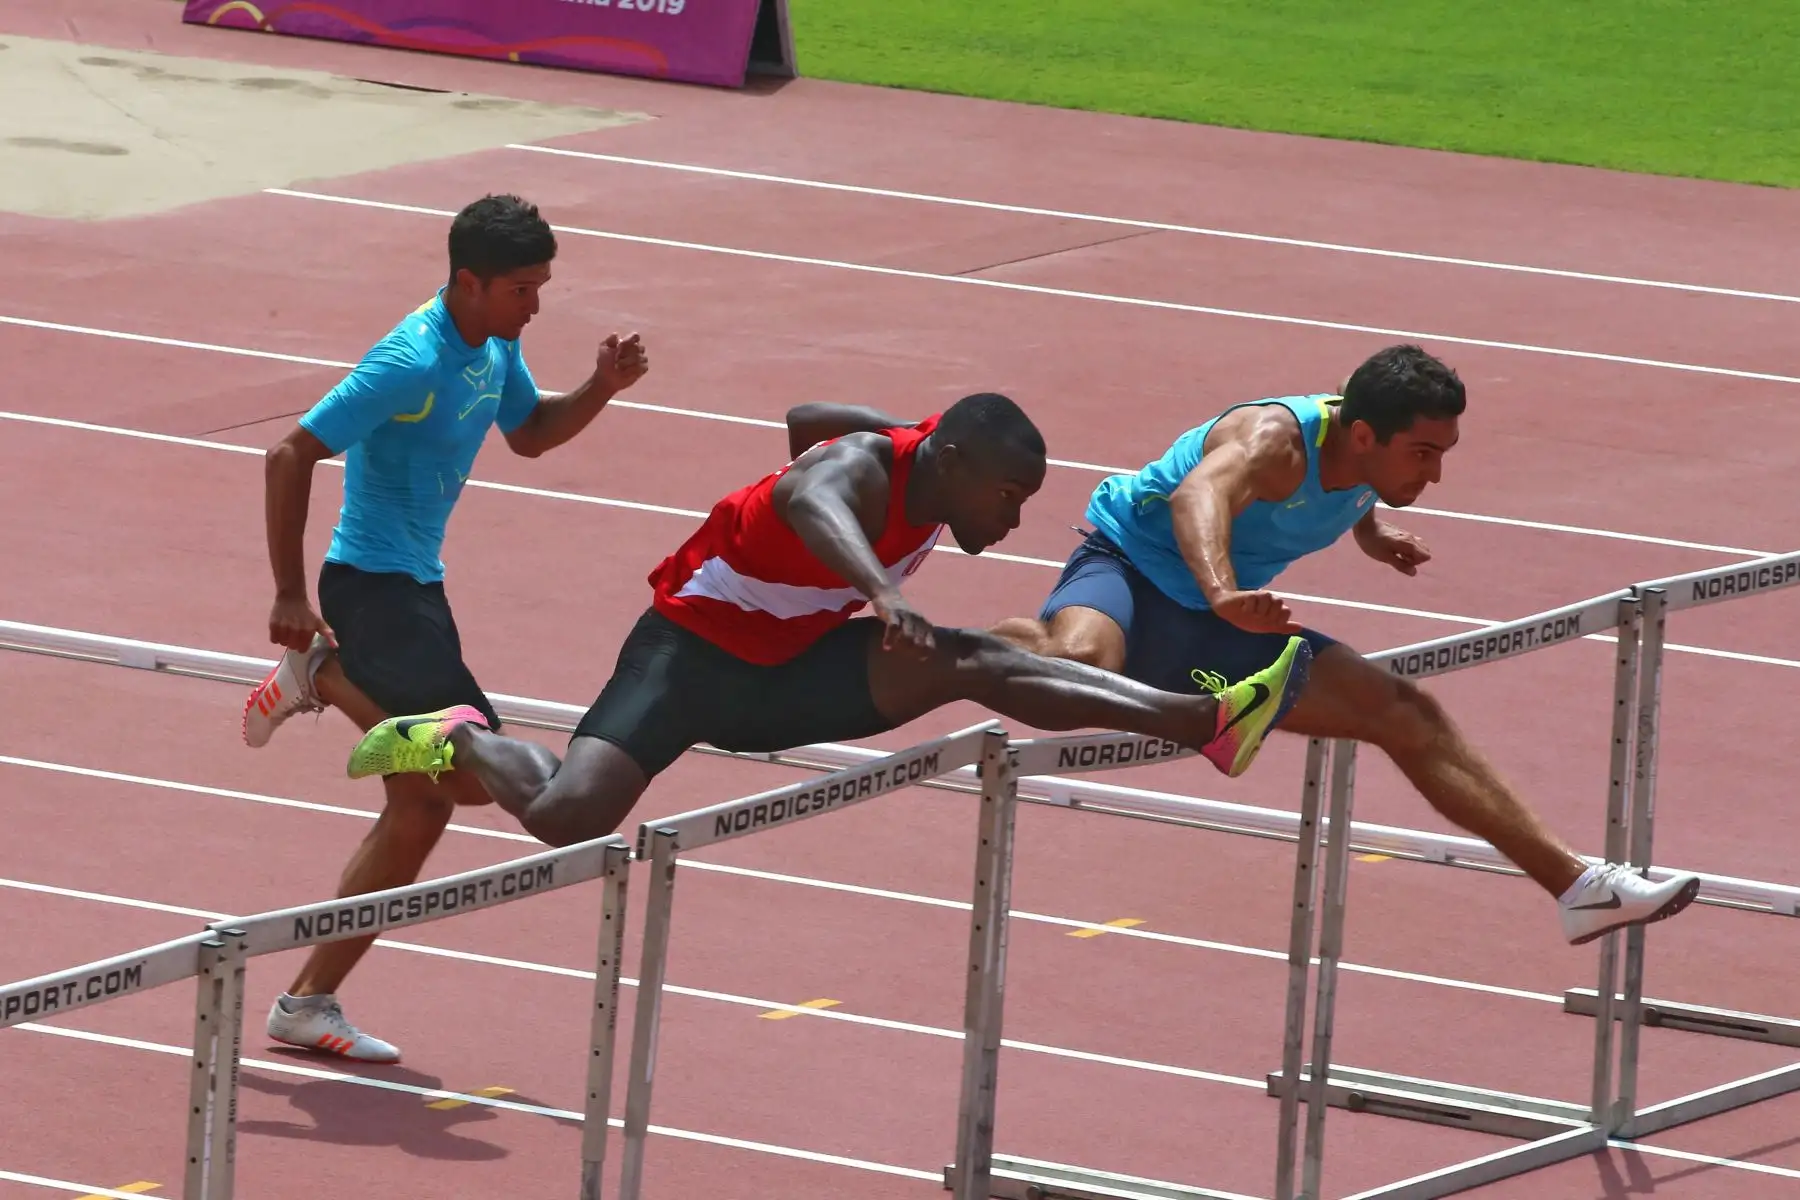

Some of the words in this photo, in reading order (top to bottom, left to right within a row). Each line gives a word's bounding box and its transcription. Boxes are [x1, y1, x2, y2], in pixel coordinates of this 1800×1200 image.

[1692, 562, 1800, 601] NORDICSP
[1391, 614, 1580, 675] NORDICSPORT.COM
[714, 752, 939, 838] NORDICSPORT.COM
[294, 863, 554, 941] NORDICSPORT.COM
[0, 965, 142, 1019] PORT.COM
